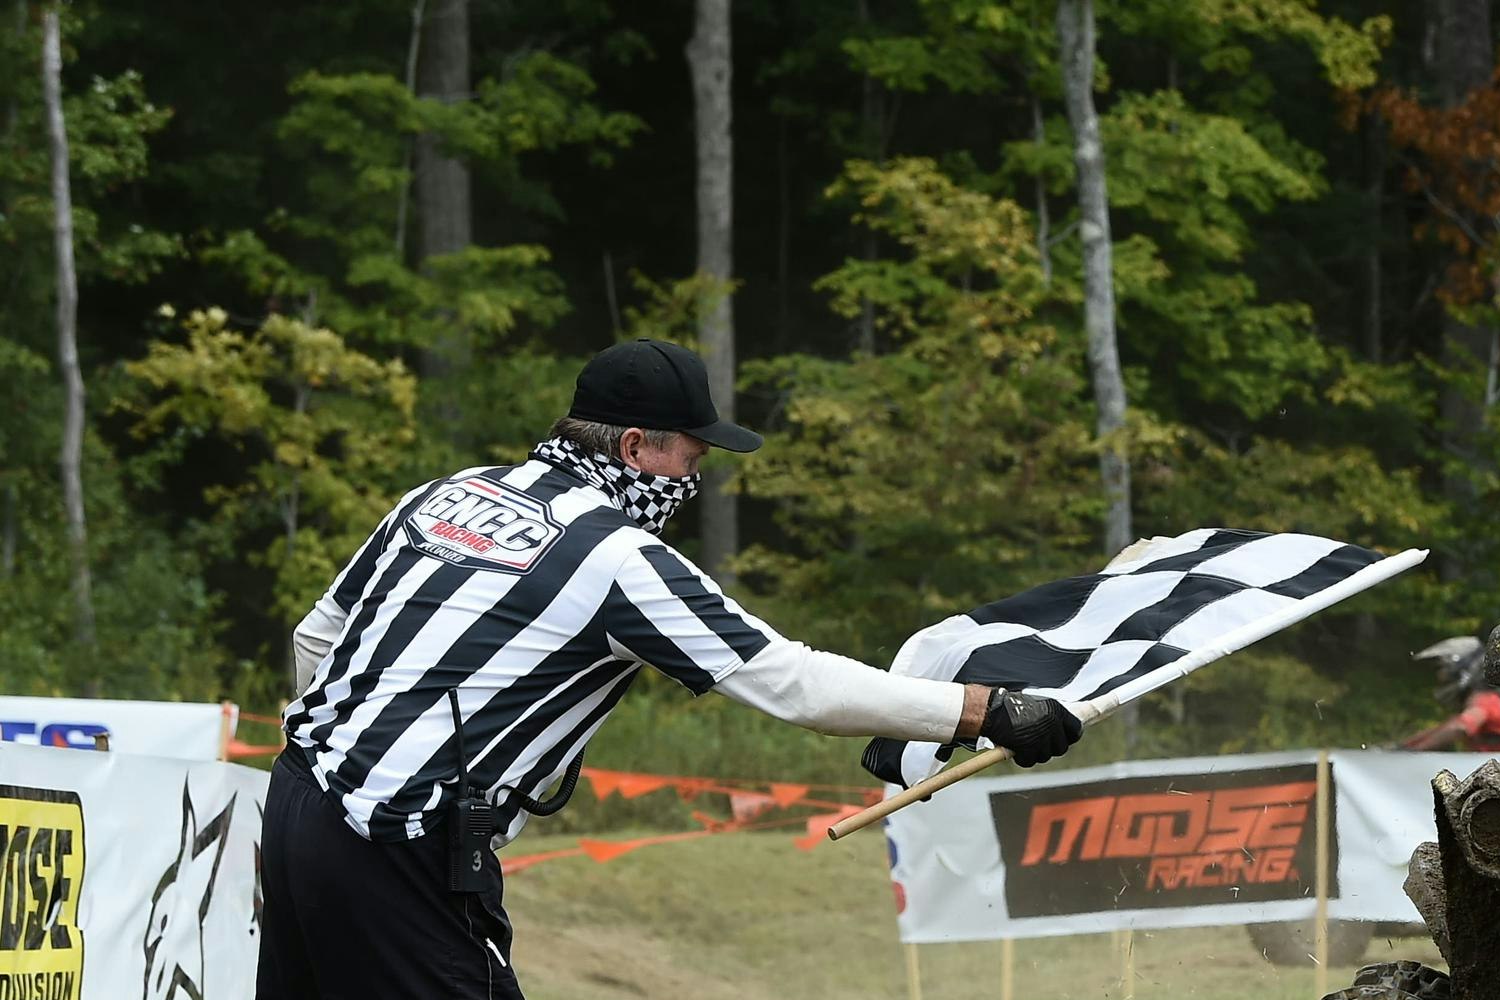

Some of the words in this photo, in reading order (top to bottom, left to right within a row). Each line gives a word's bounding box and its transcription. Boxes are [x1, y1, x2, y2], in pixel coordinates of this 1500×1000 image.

[419, 487, 549, 551] GNCC
[426, 520, 496, 554] RACING
[1021, 781, 1318, 866] MOOSE
[0, 824, 73, 950] OSE
[1147, 848, 1294, 890] RACING
